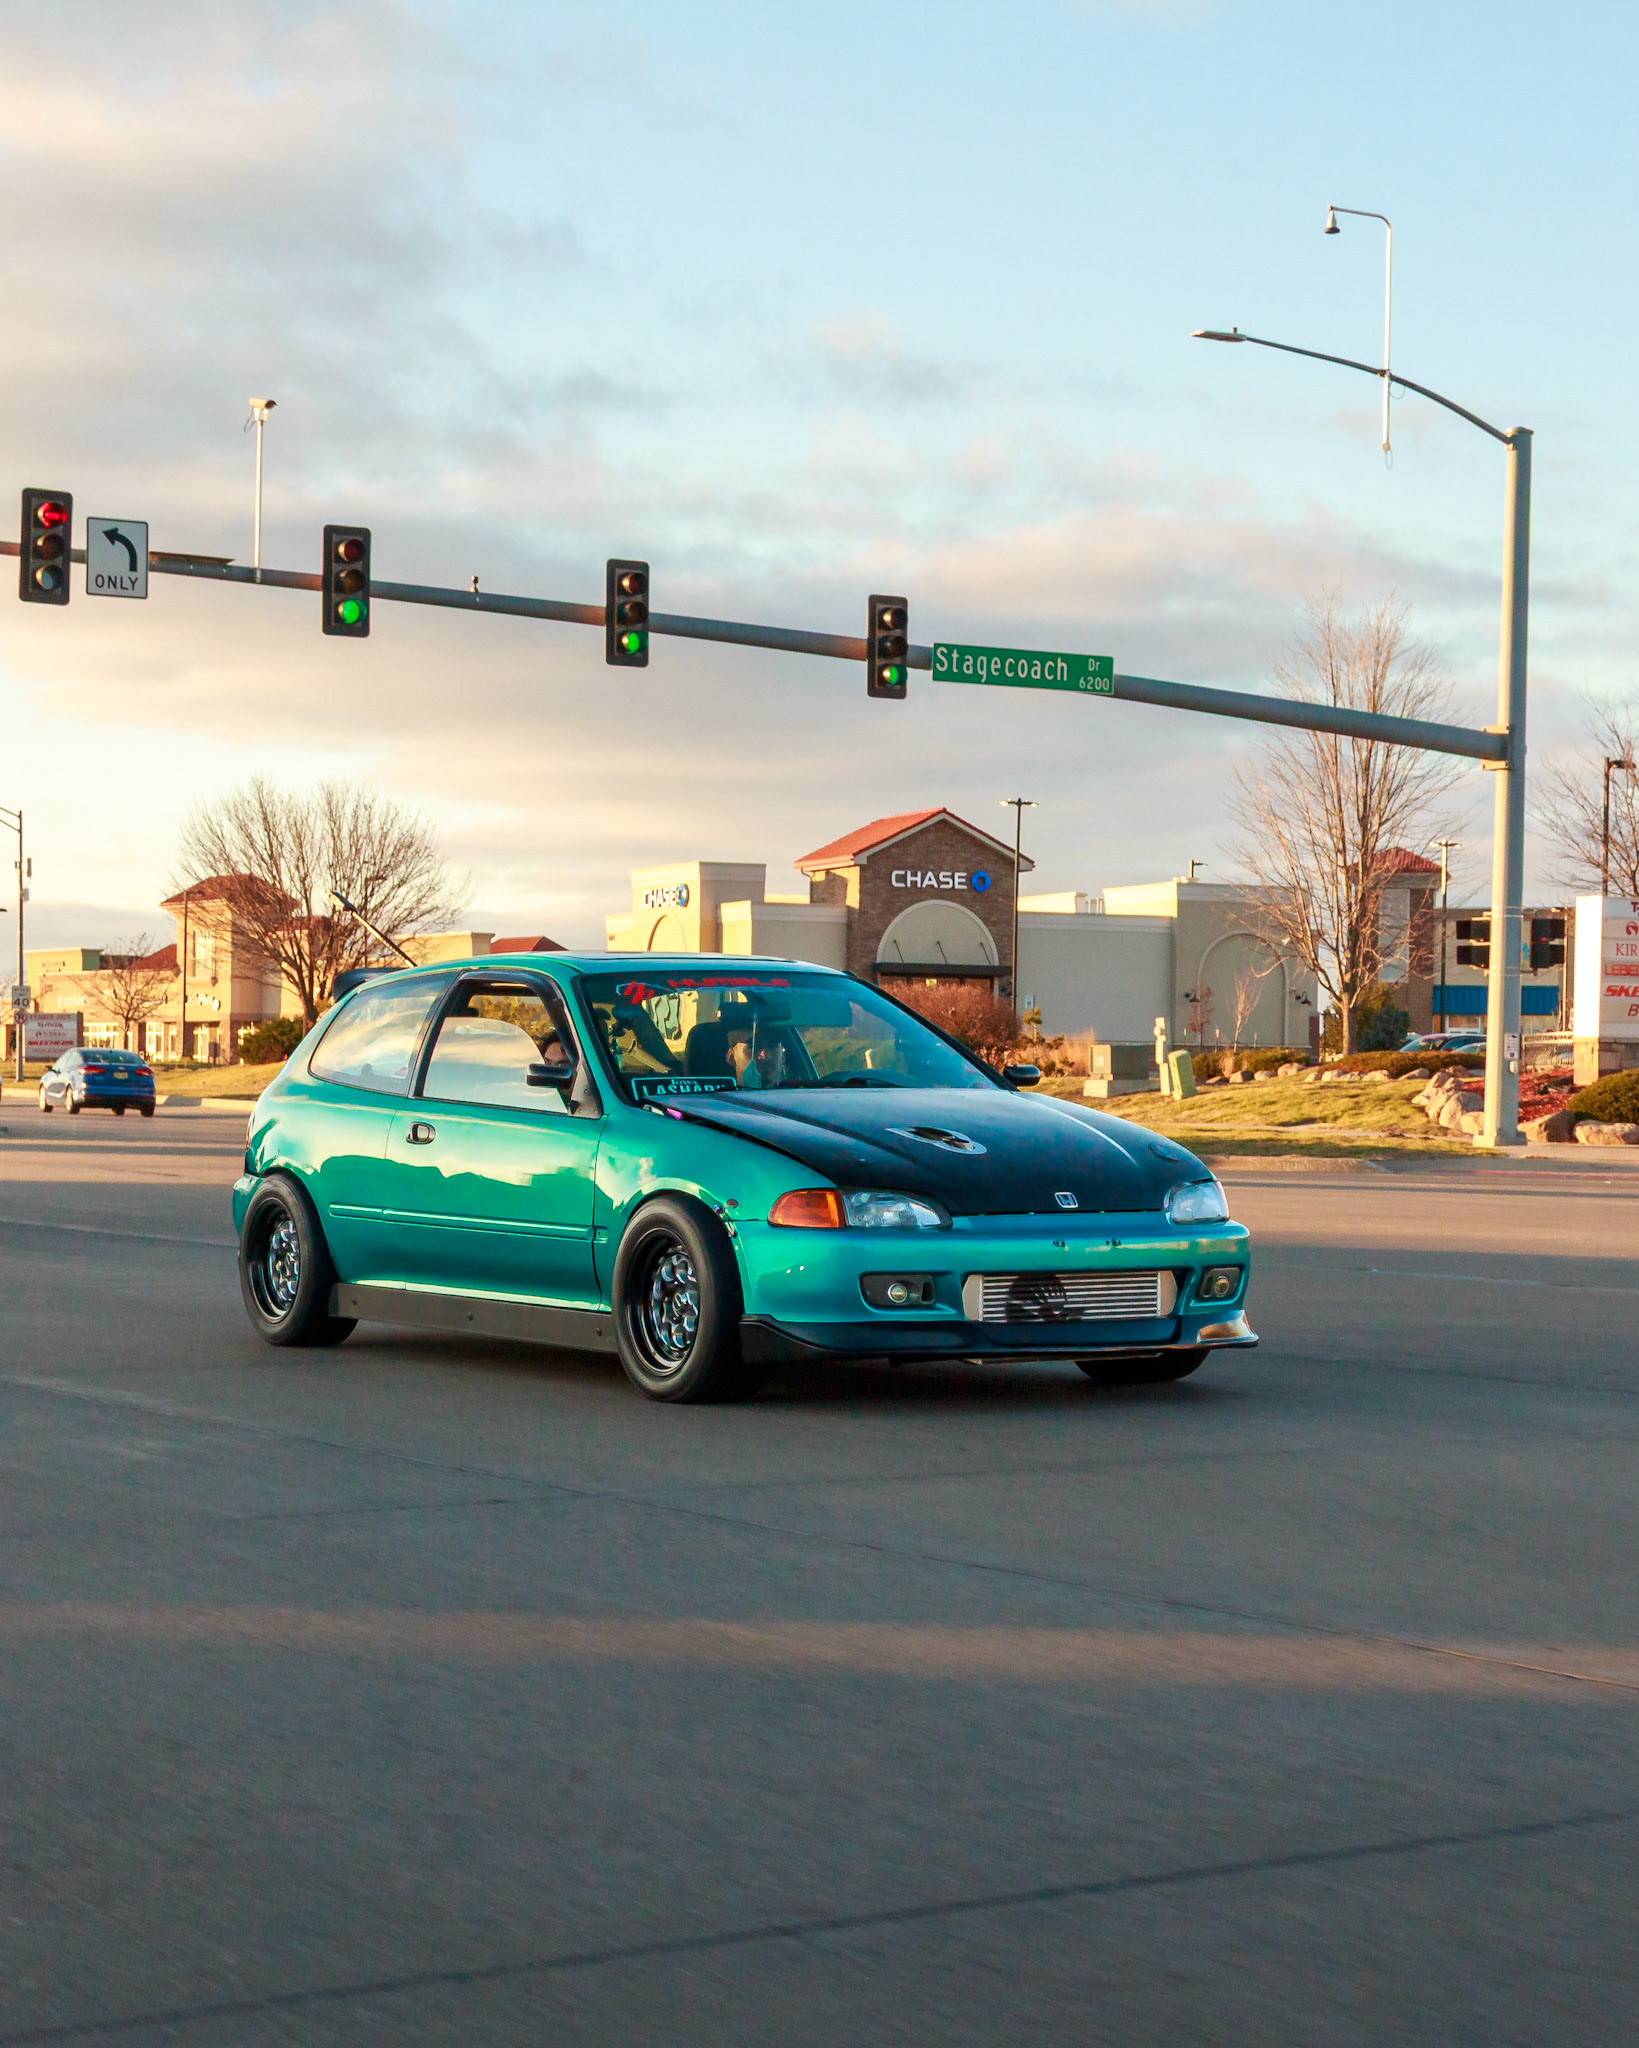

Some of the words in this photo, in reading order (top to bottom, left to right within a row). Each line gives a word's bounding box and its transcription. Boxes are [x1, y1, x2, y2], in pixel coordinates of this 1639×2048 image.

[95, 574, 139, 591] ONLY
[935, 646, 1068, 683] Stagecoach
[1088, 658, 1101, 671] Dr
[1079, 676, 1110, 690] 6200
[891, 870, 968, 889] CHASE
[643, 886, 678, 909] CHASE
[13, 998, 30, 1007] 40
